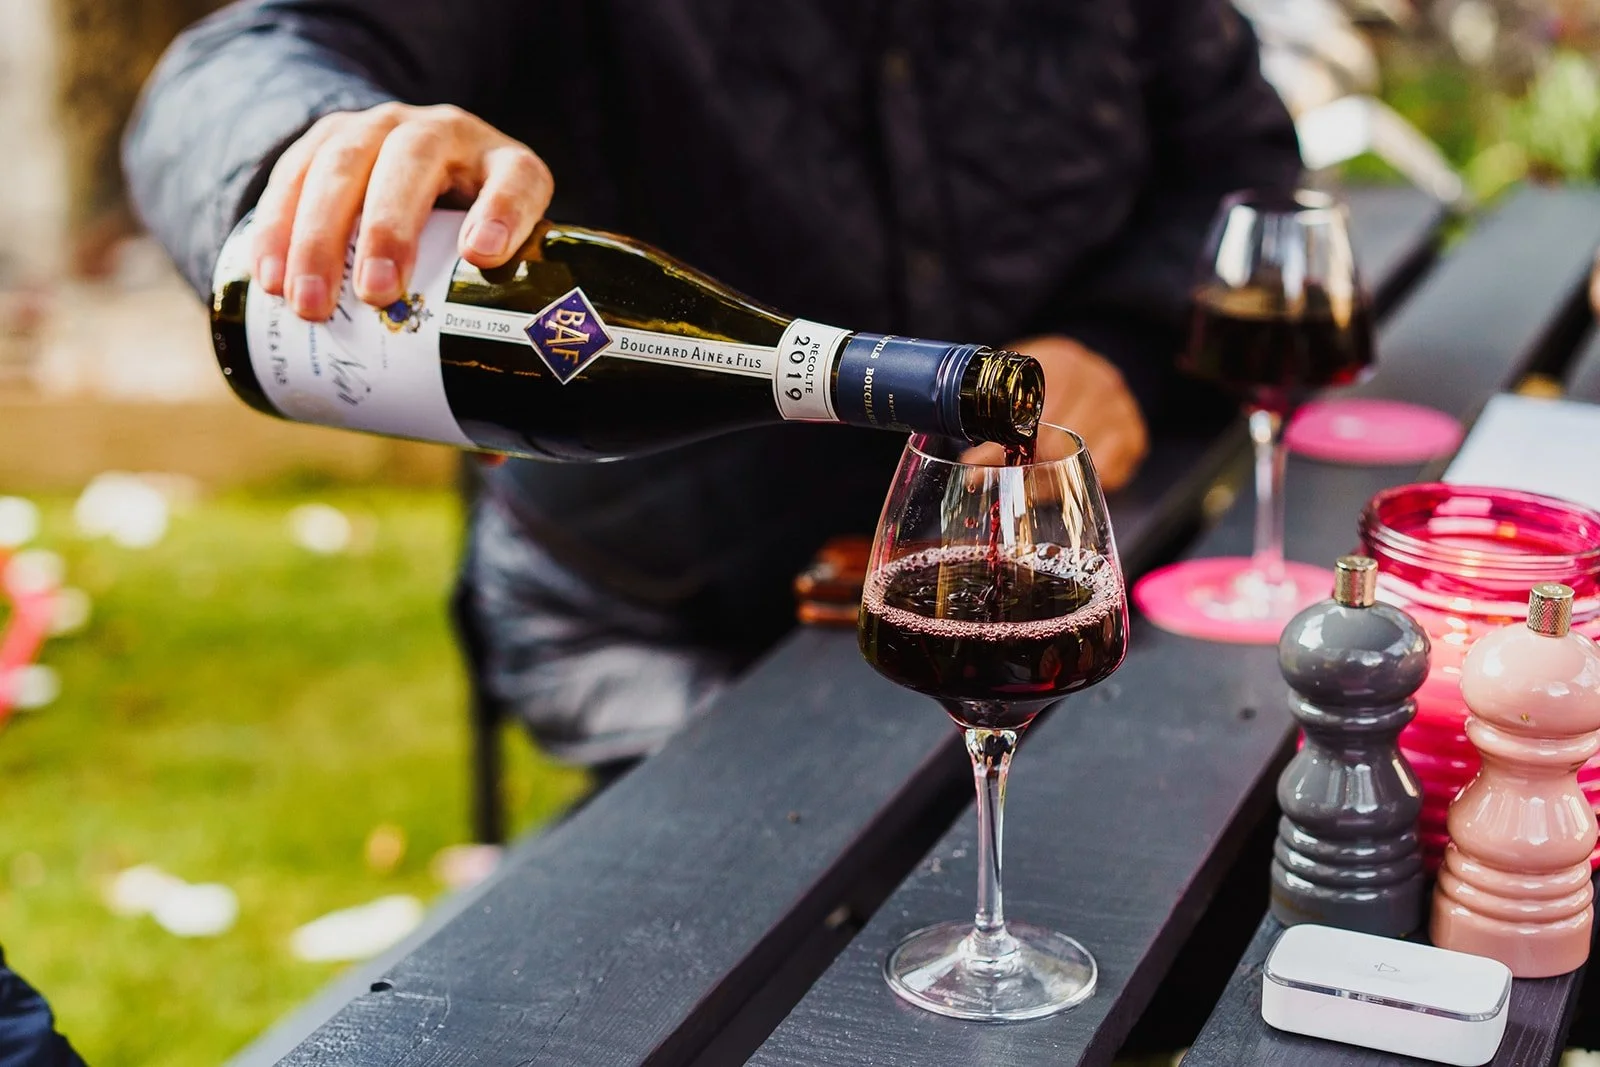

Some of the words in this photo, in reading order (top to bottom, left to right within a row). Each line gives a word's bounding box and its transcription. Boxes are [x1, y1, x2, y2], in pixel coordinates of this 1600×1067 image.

[545, 308, 591, 366] BAF
[620, 336, 688, 359] BOUCHARD
[726, 355, 733, 365] &
[736, 353, 762, 369] FILS
[784, 335, 812, 401] 2019
[804, 342, 821, 394] RÉCOLTE
